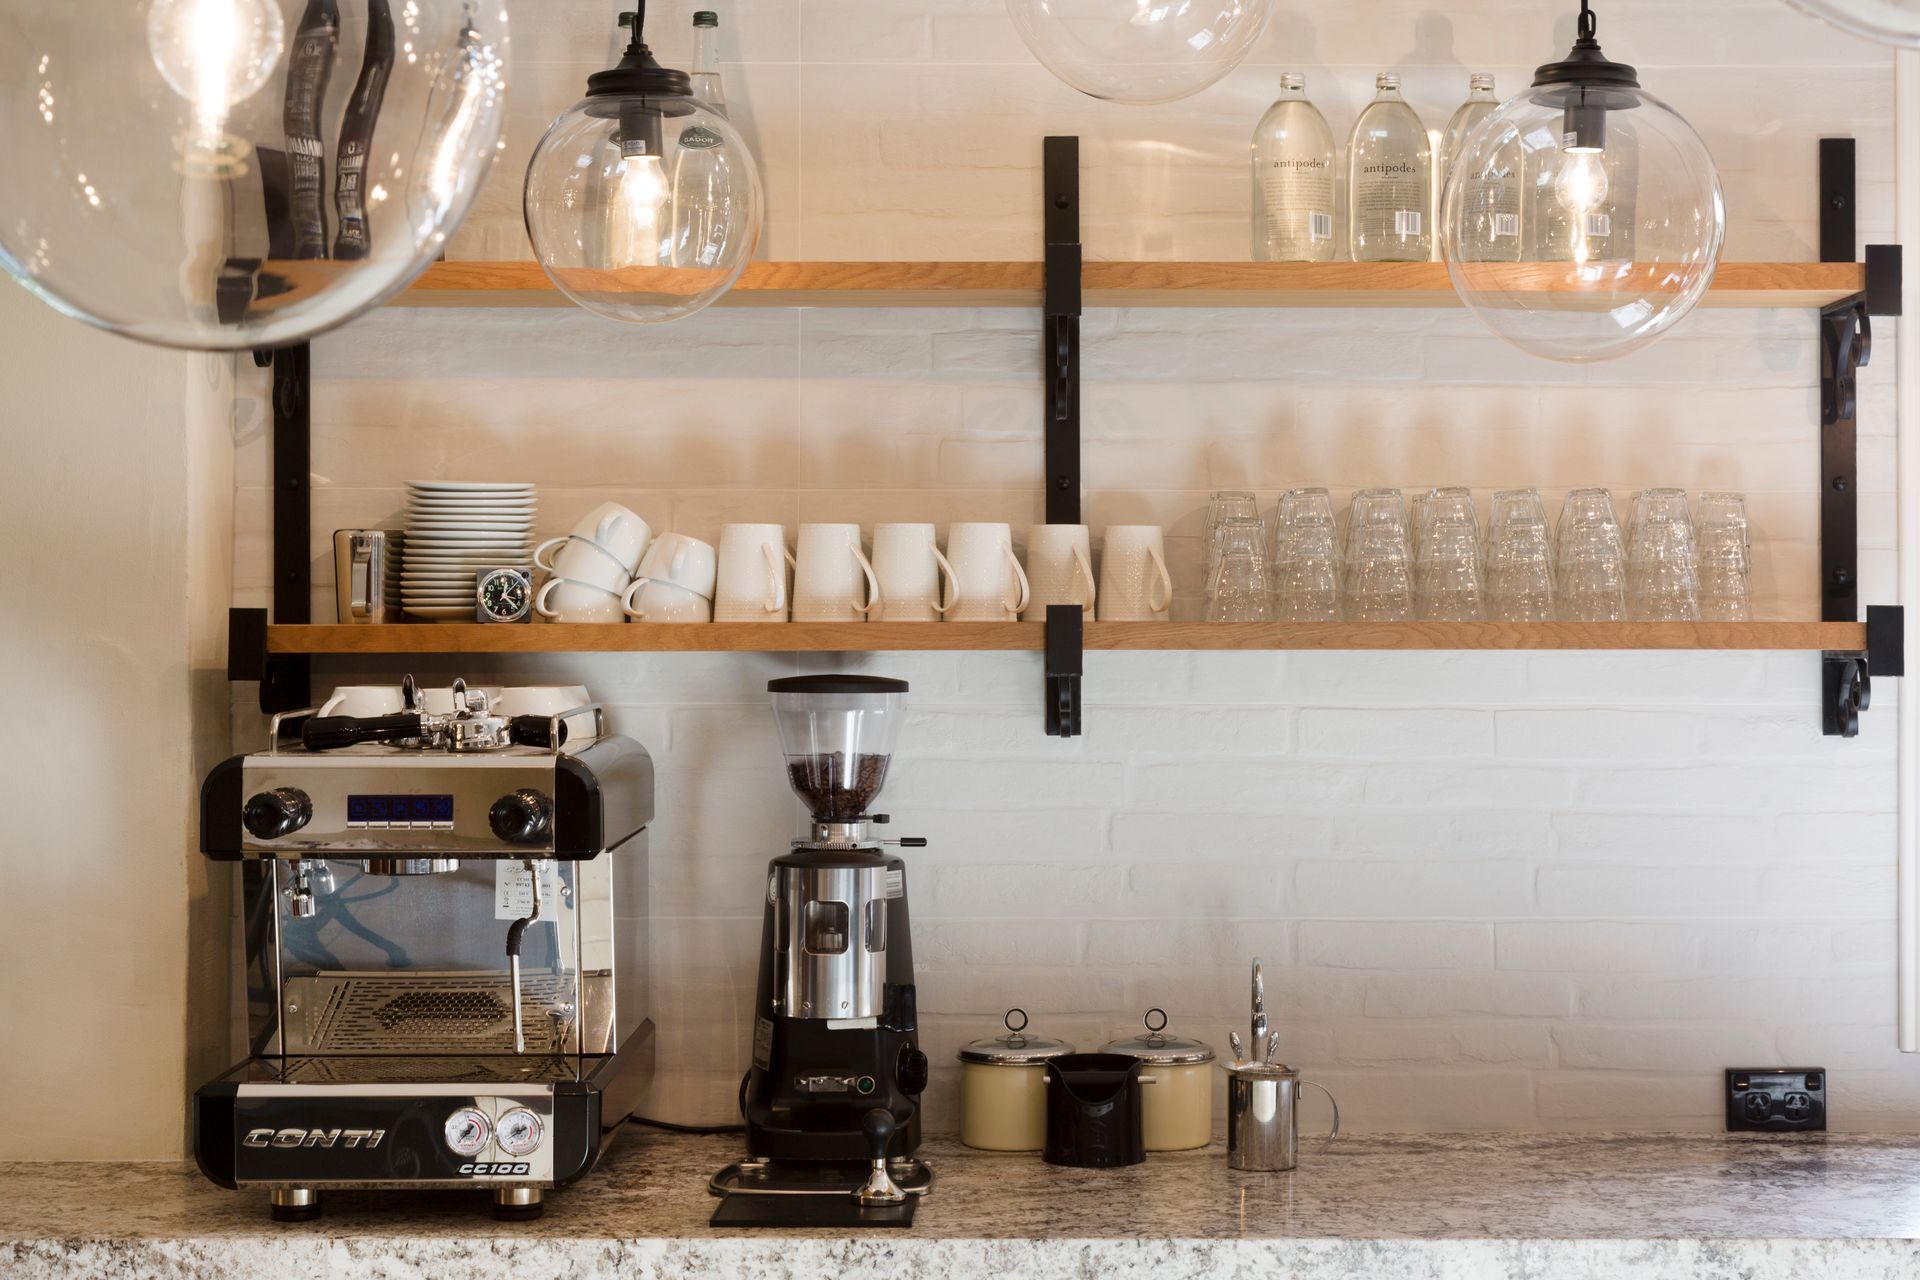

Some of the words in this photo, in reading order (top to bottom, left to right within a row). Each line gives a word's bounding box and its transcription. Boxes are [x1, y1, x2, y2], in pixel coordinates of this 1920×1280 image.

[1273, 158, 1326, 170] antipodes
[1364, 163, 1416, 175] antipodes
[242, 1128, 386, 1148] CONTI
[459, 1164, 528, 1174] CC100
